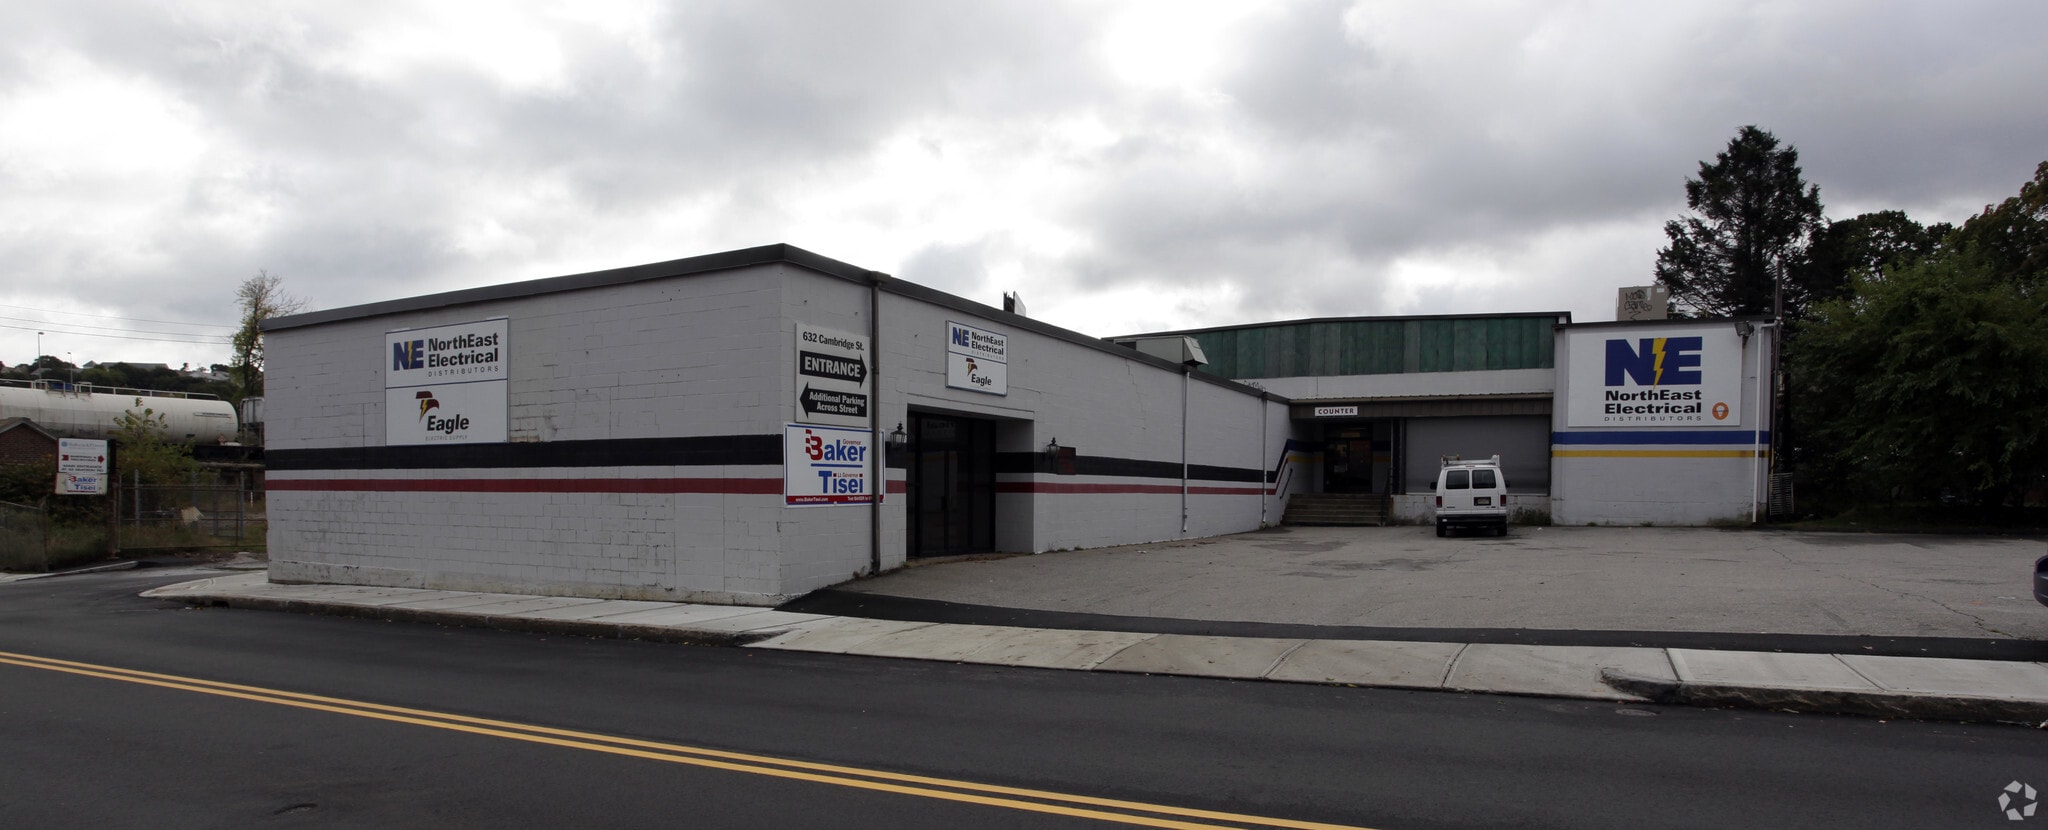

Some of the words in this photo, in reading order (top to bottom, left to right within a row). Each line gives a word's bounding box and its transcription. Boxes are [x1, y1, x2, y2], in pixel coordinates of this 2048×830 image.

[428, 332, 499, 352] NorthEast
[802, 331, 818, 343] 632
[818, 334, 855, 351] Cambridge
[855, 341, 865, 351] St.
[952, 327, 969, 347] NE
[971, 331, 1004, 347] NorthEast
[393, 339, 424, 371] NE
[428, 348, 499, 368] Electrical
[971, 340, 1004, 356] Electrical
[428, 365, 499, 377] DISTRIBUTORS
[804, 356, 861, 378] ENTRANCE
[1604, 337, 1703, 386] NE
[971, 373, 992, 387] Eagle
[809, 391, 841, 403] Additional
[841, 394, 865, 407] Parking
[1605, 389, 1702, 401] NorthEast
[816, 401, 838, 412] Across
[838, 404, 858, 414] Street
[1604, 402, 1702, 414] Electrical
[427, 414, 469, 434] Eagle
[805, 429, 867, 462] Baker
[818, 470, 864, 494] Tisei
